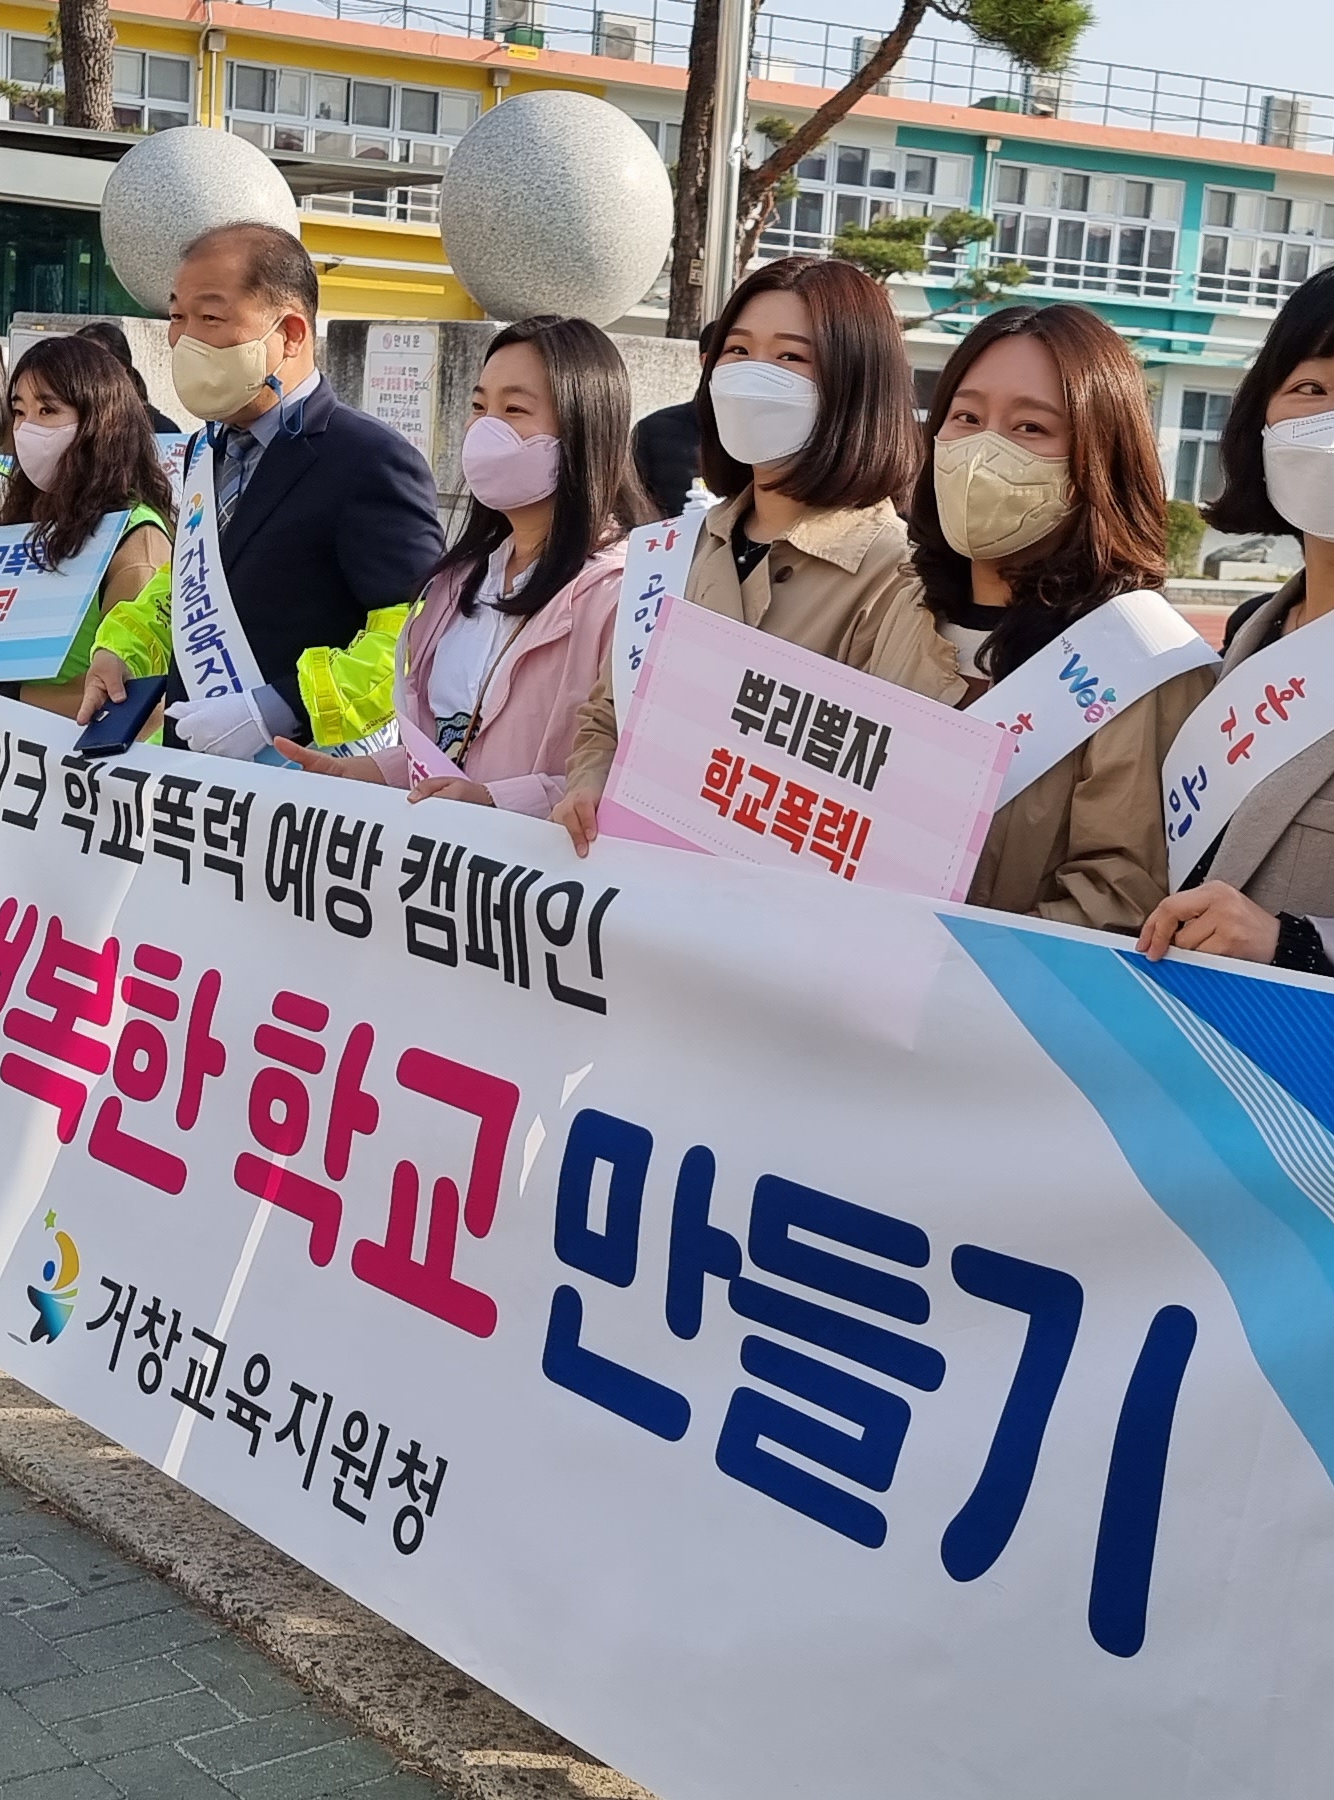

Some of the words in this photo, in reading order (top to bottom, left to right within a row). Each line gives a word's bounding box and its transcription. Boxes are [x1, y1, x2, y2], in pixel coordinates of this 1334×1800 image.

[394, 334, 420, 349] 안내문
[730, 667, 893, 793] 뿌리뽑자
[1058, 652, 1106, 724] Wee
[1219, 676, 1307, 766] 혼자
[699, 746, 872, 882] 학교폭력!
[58, 754, 257, 903] 학교폭력
[266, 801, 385, 940] 예방
[398, 832, 622, 1017] 캠페인
[233, 989, 521, 1339] 학교
[541, 1107, 1198, 1659] 만들기
[85, 1274, 450, 1556] 거창교육지원청
